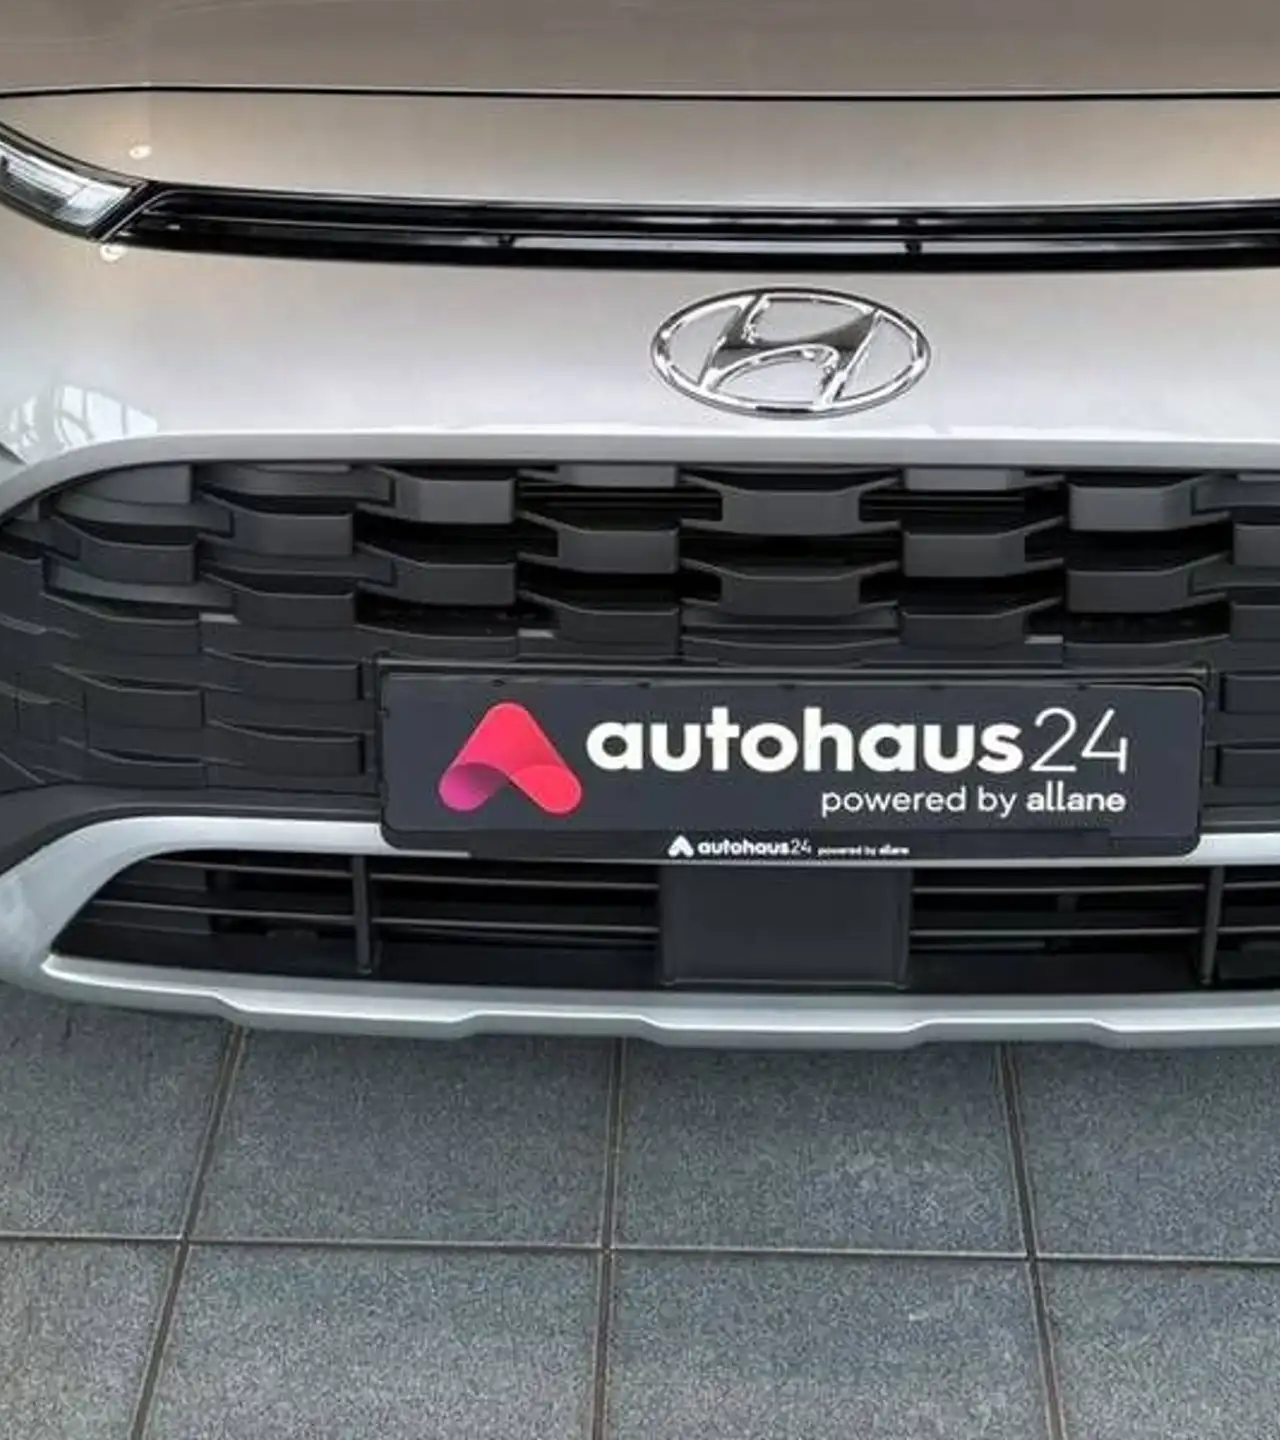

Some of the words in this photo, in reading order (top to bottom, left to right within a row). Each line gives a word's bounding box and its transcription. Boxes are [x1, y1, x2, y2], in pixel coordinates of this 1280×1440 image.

[585, 706, 1128, 774] autohaus24
[821, 788, 967, 817] powered
[977, 785, 1018, 819] by
[1025, 782, 1127, 813] allane
[696, 837, 812, 856] autohaus24
[817, 845, 863, 856] powered
